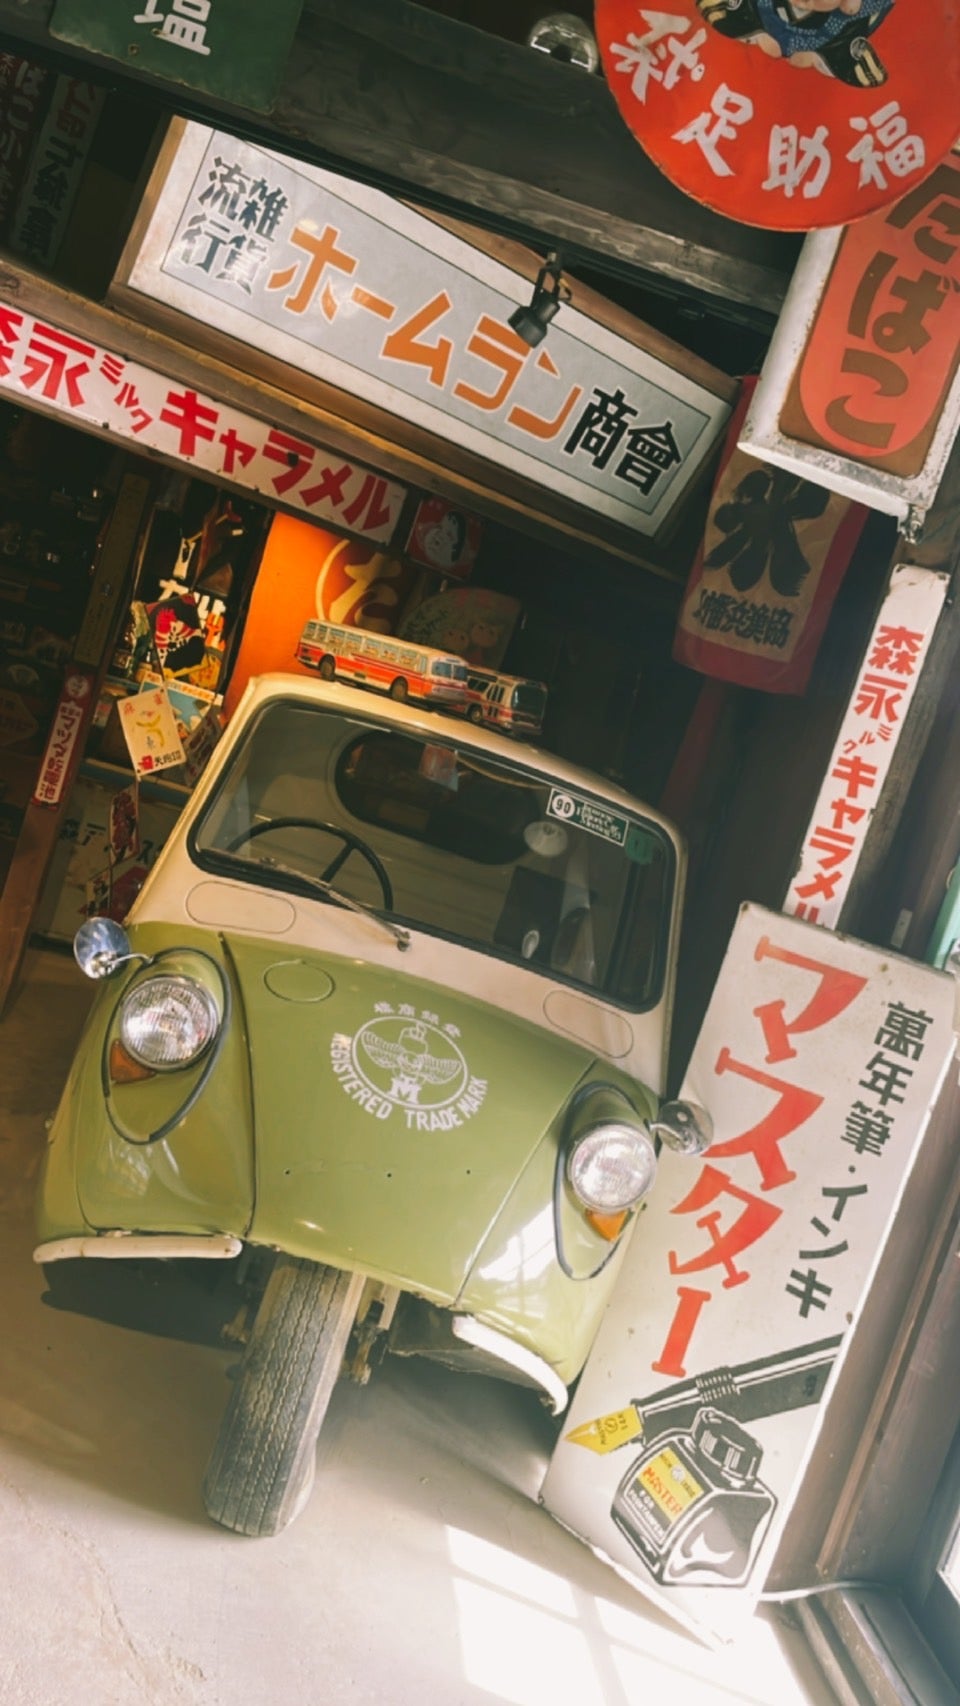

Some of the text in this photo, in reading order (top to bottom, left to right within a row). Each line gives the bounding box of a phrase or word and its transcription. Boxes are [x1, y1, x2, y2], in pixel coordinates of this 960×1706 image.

[825, 163, 960, 449] たばこ
[554, 796, 572, 813] 90
[330, 1032, 488, 1132] REGISTERED TRADE MARK
[651, 935, 868, 1378] マスター
[642, 1466, 683, 1515] MASTER
